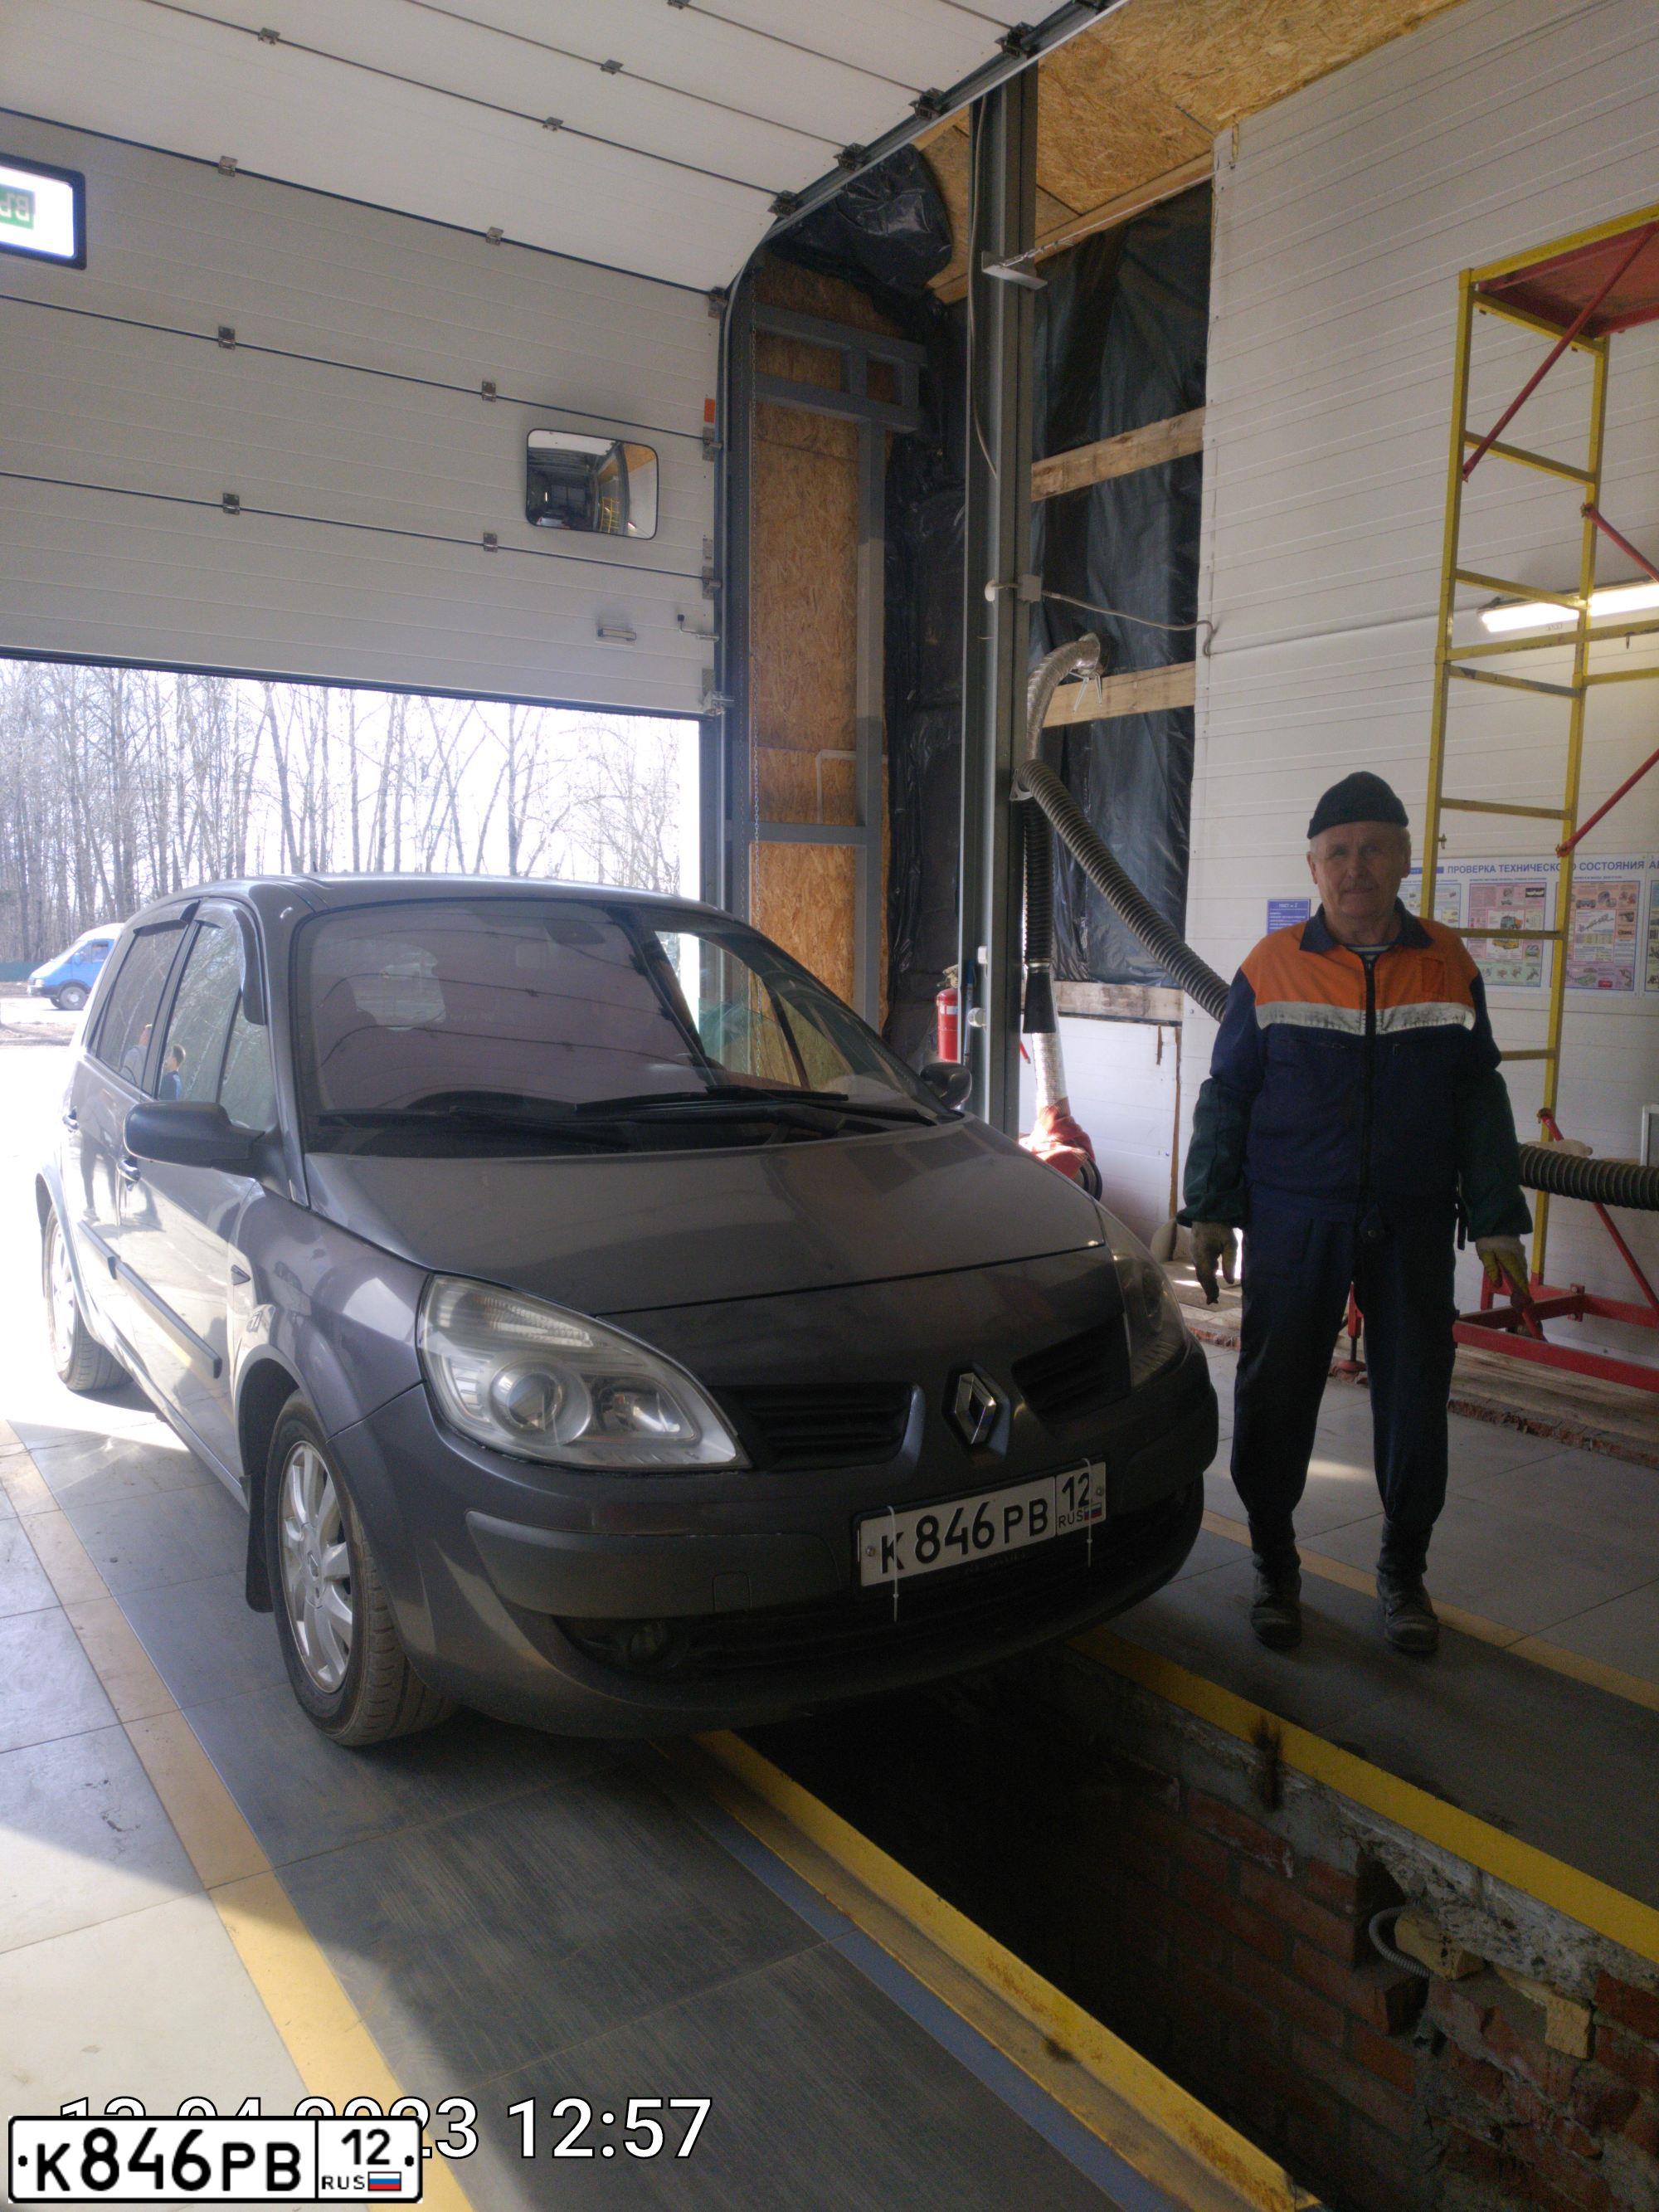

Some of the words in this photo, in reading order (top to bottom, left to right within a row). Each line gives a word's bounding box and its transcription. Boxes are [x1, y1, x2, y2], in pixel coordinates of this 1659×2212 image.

[1447, 865, 1496, 874] ПРОВЕРКА
[1498, 863, 1576, 873] ТЕХНИЧЕСКО
[1579, 861, 1645, 871] СОСТОЯНИЯ
[880, 1497, 1048, 1575] К846РВ
[1062, 1471, 1091, 1512] 12
[1058, 1508, 1083, 1528] RUS
